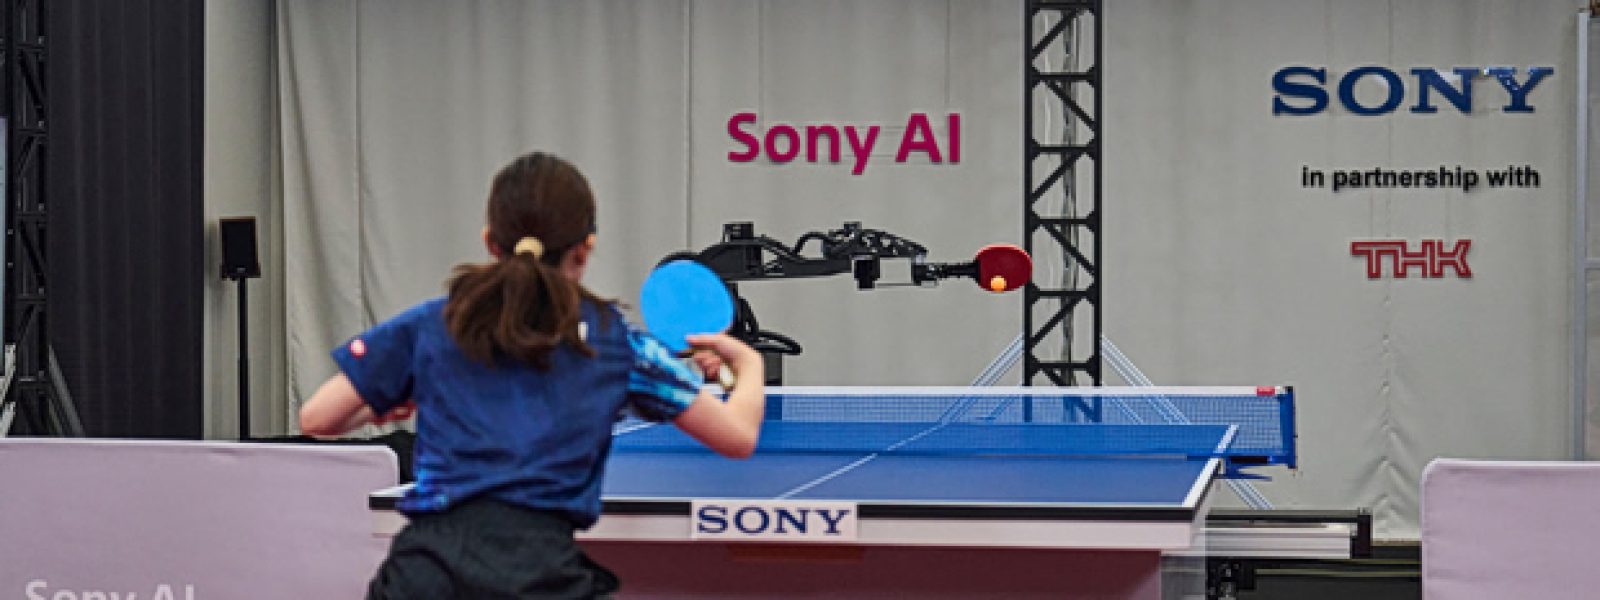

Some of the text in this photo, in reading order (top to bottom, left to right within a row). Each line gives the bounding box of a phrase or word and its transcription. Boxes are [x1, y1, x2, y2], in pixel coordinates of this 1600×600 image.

[1271, 66, 1554, 116] SONY
[727, 112, 961, 175] Sony AI
[1302, 165, 1541, 193] in partnership with
[1350, 239, 1472, 279] THK
[696, 505, 850, 535] SONY
